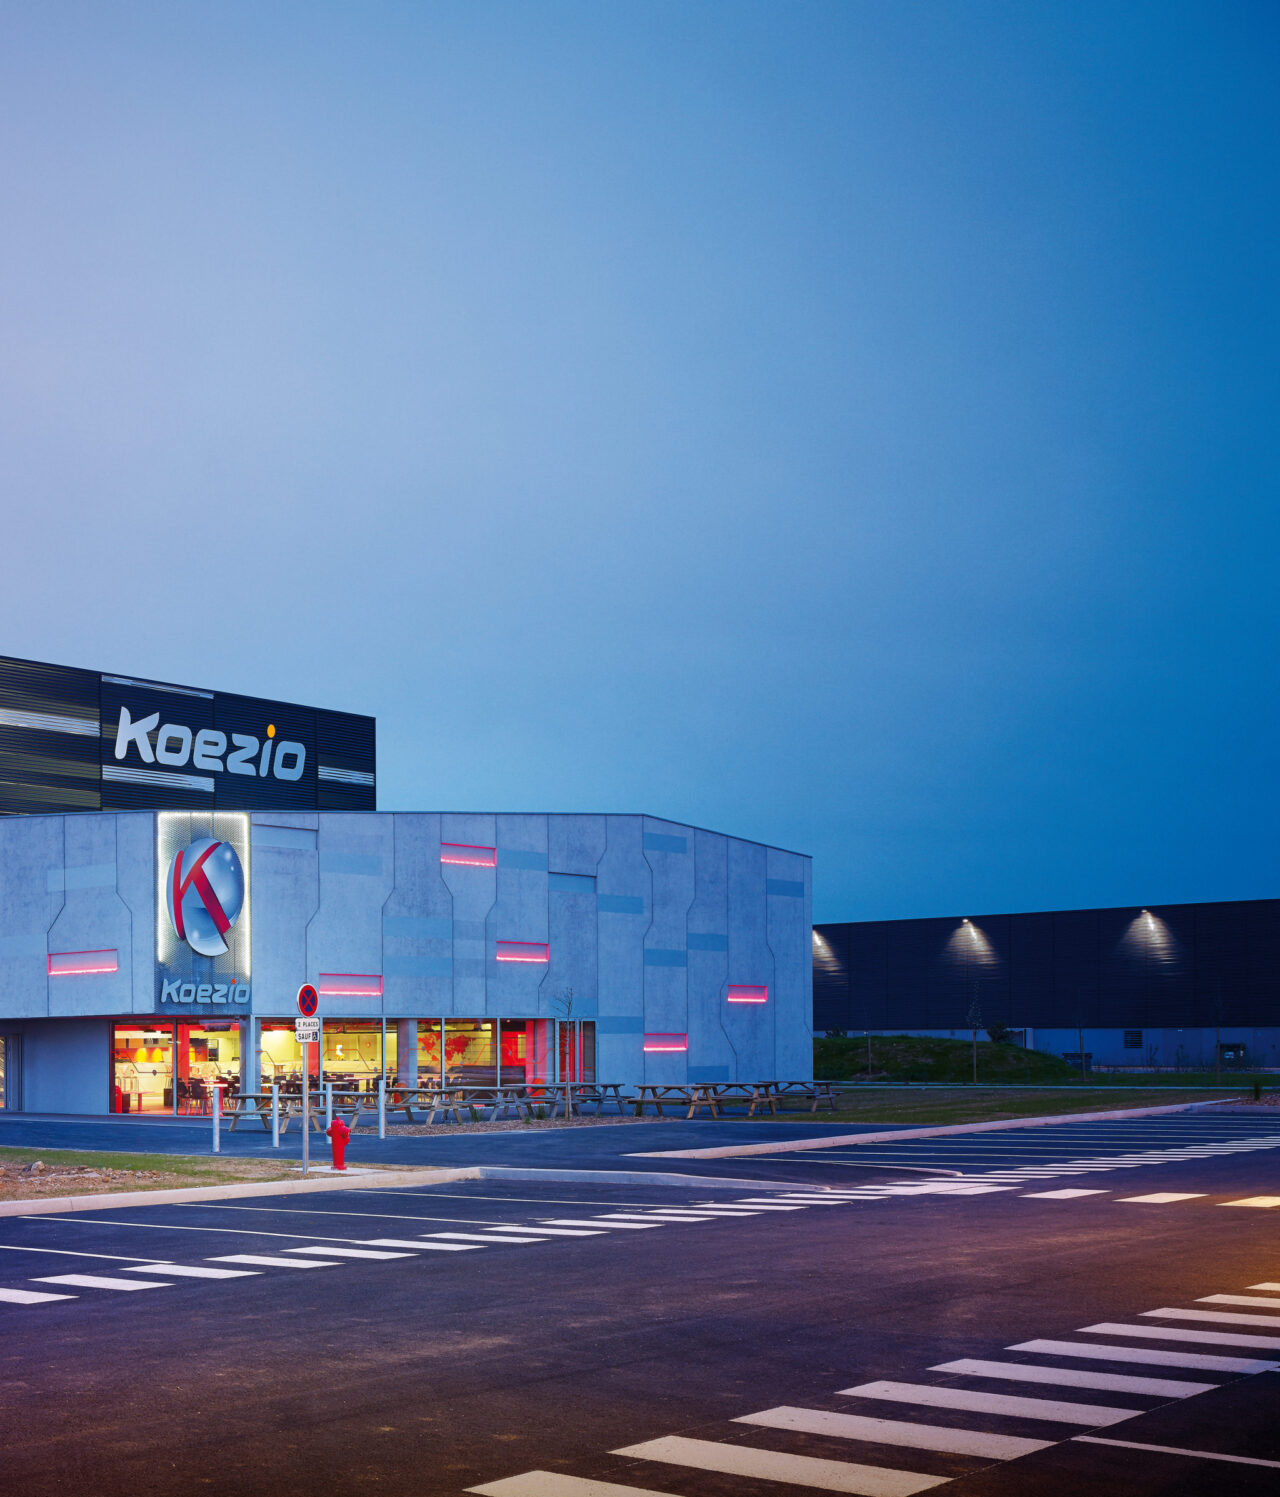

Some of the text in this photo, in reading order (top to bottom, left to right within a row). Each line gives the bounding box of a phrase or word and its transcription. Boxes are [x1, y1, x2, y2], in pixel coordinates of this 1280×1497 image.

[115, 706, 306, 781] Koezio
[161, 978, 250, 1004] Koezio
[297, 1032, 311, 1041] SAUF
